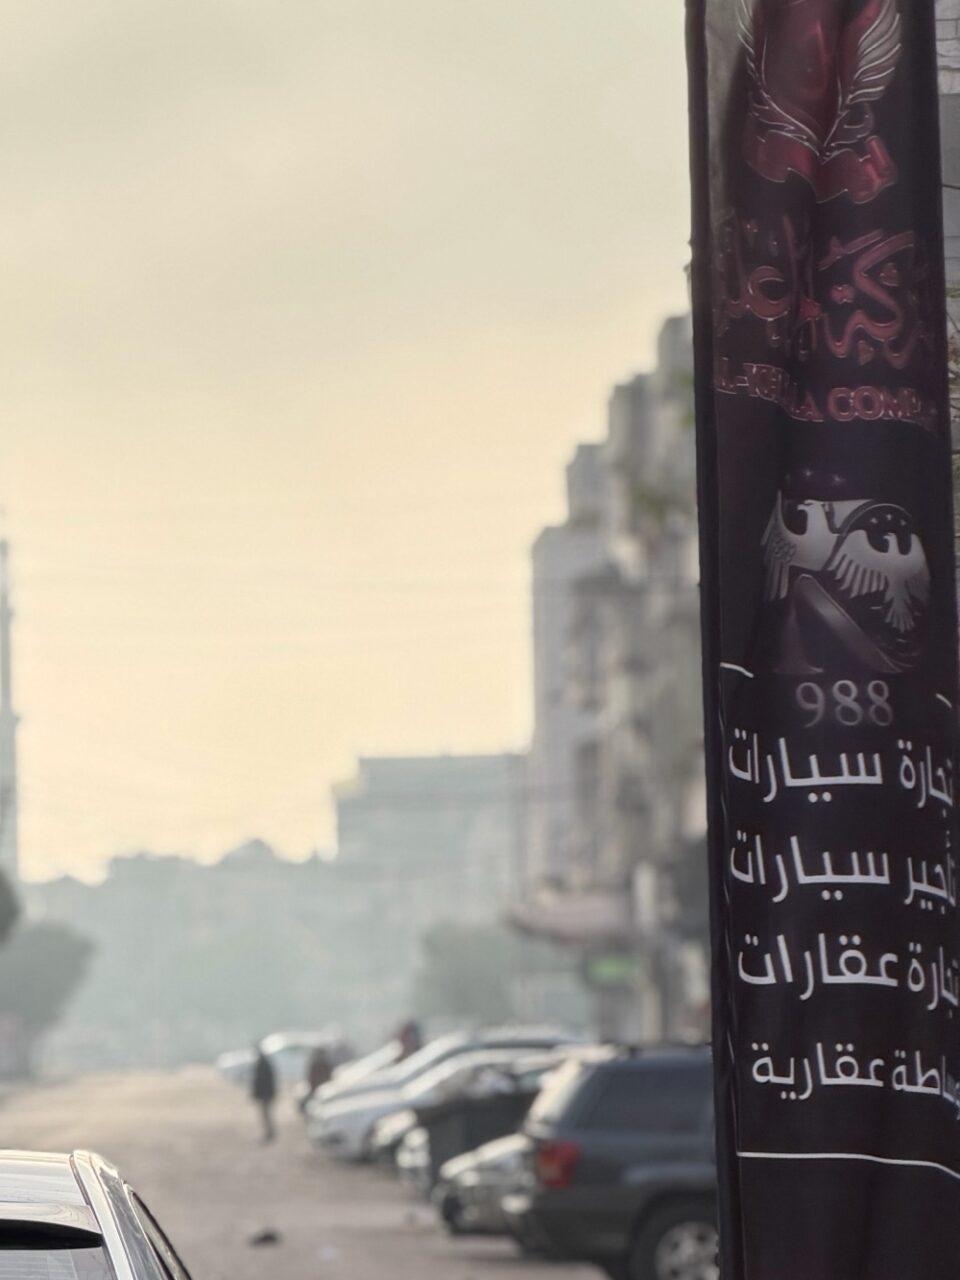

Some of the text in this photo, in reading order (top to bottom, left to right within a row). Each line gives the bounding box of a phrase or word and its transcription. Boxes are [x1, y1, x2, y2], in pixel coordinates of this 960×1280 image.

[795, 679, 893, 728] 988
[728, 728, 883, 803] سيارات
[730, 830, 890, 903] سيارات
[738, 932, 898, 1001] عقارات
[752, 1042, 885, 1100] عقارية
